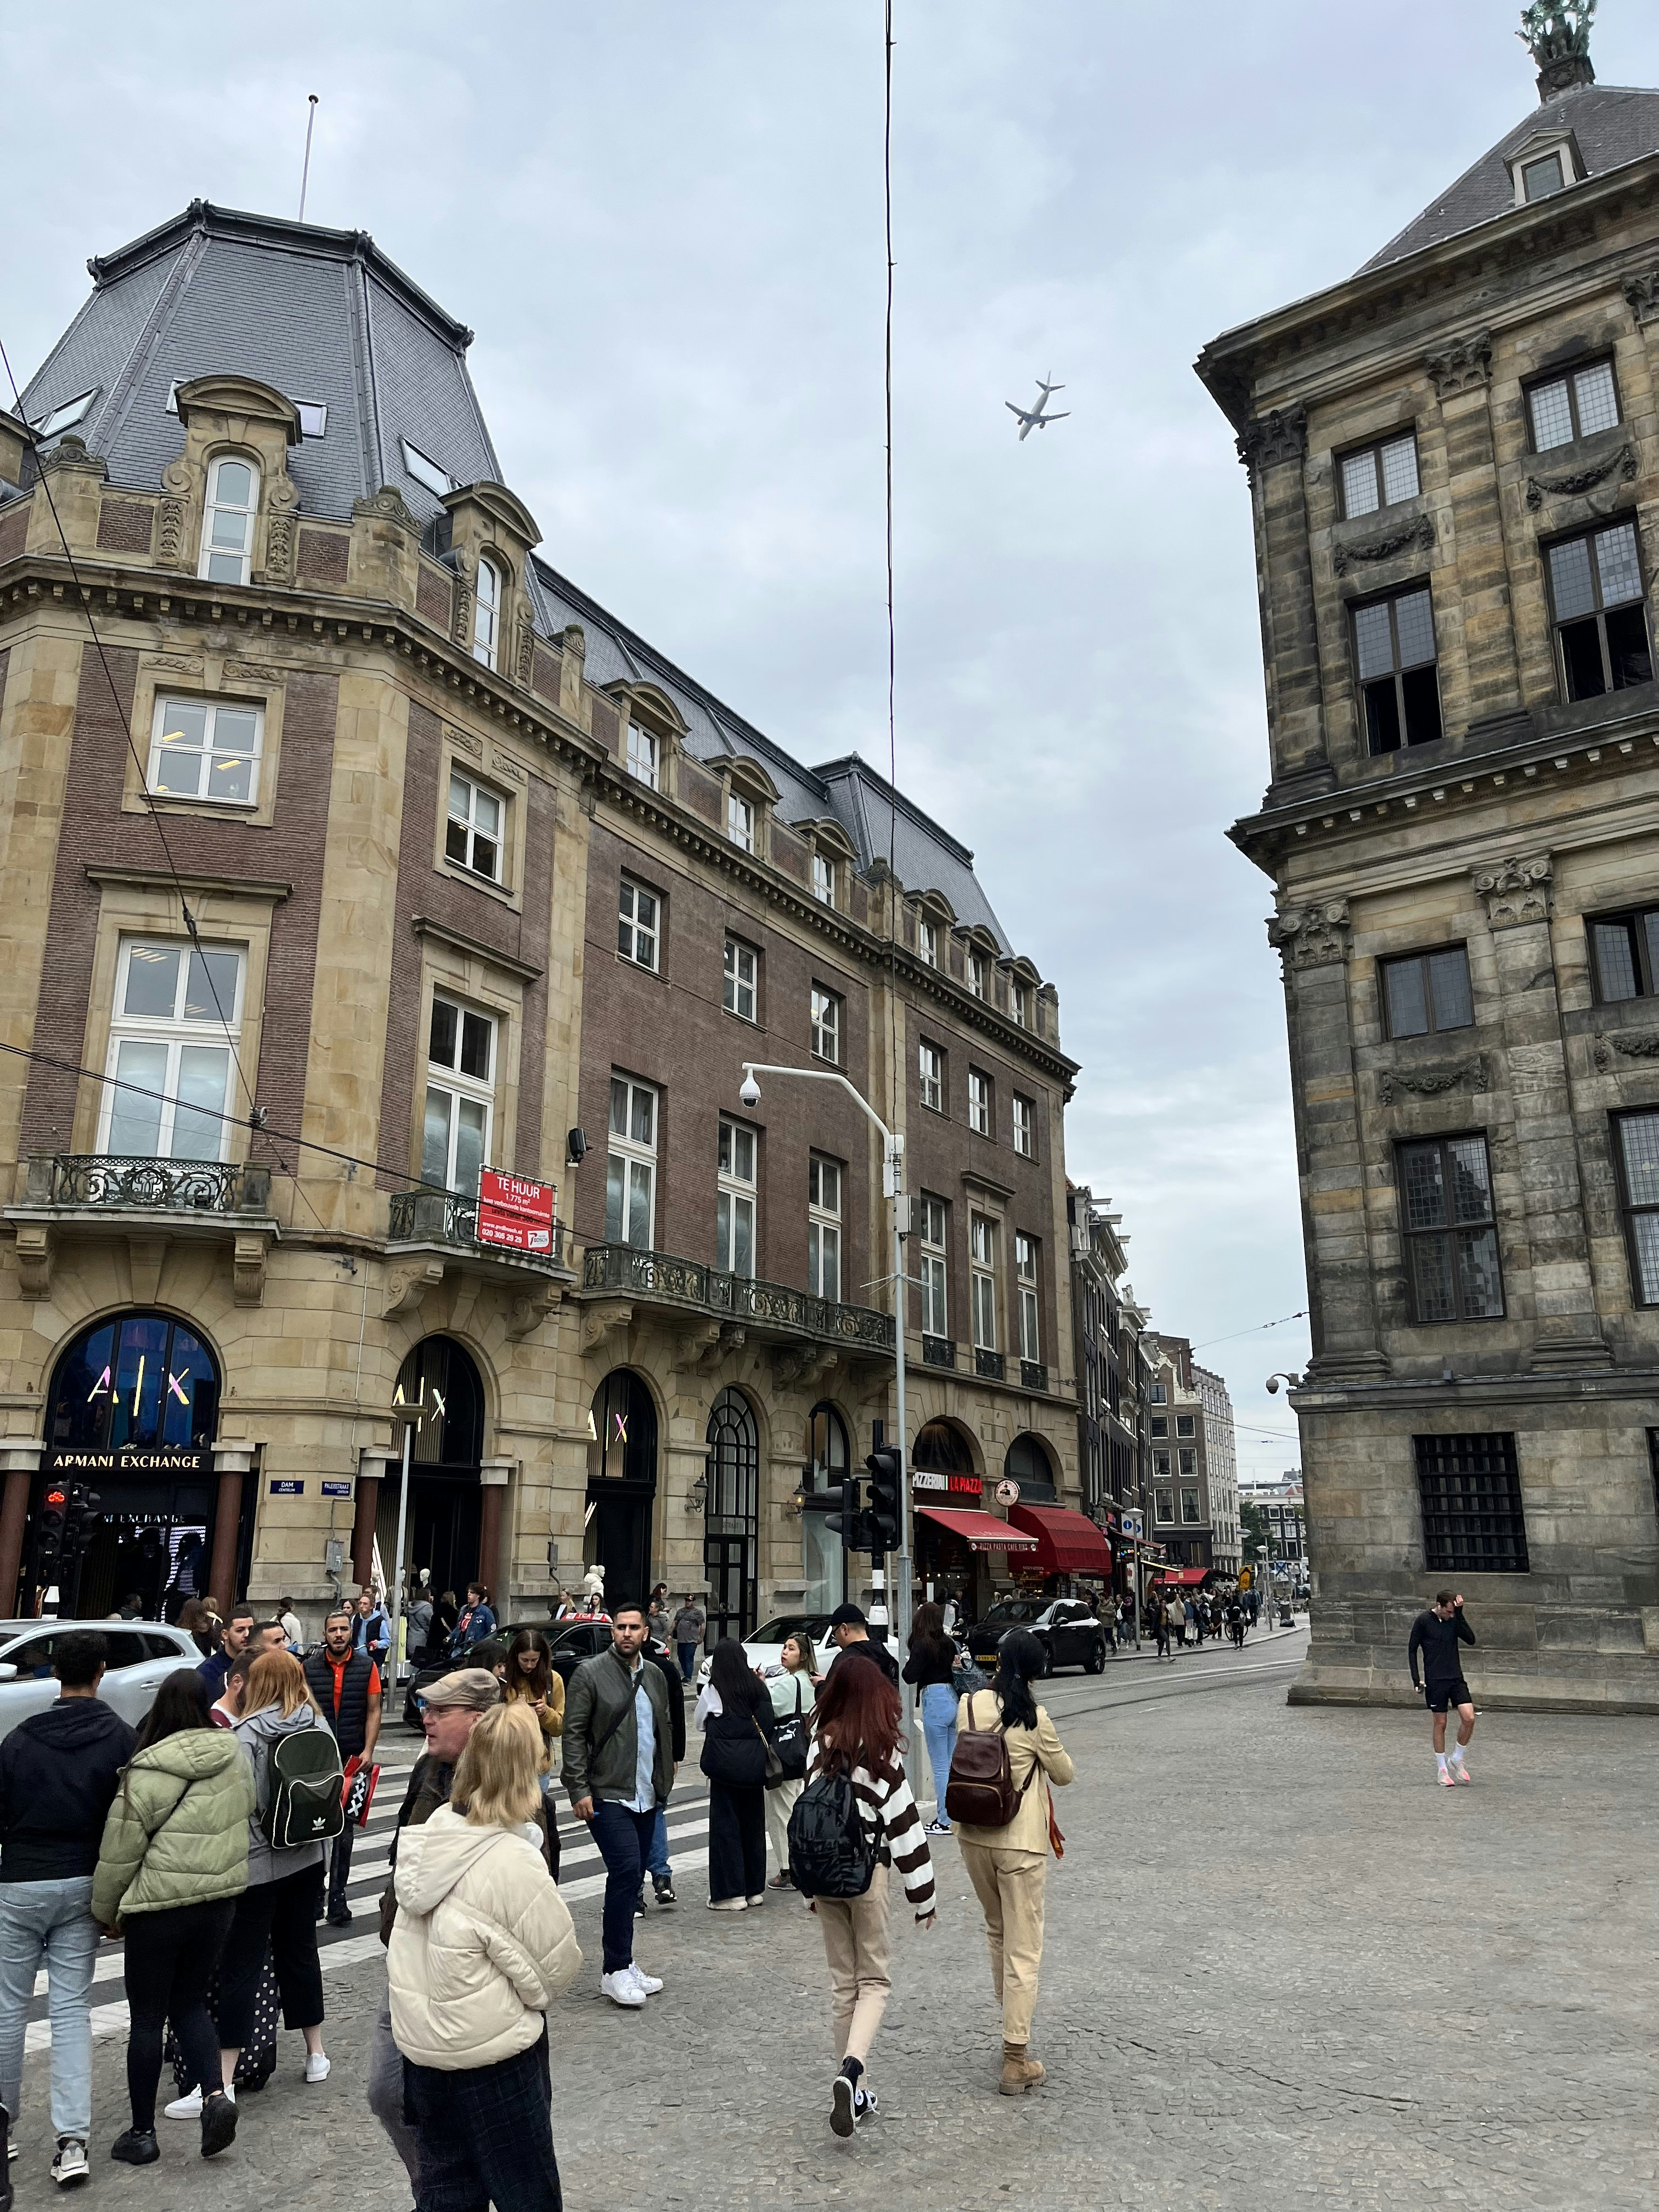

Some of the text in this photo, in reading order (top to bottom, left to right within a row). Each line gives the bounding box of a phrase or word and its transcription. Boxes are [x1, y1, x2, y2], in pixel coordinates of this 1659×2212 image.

[497, 1176, 540, 1199] TE HUUR
[506, 1193, 522, 1204] 1.775
[482, 1228, 494, 1237] 020
[53, 1455, 201, 1468] ARMANI EXCHANGE
[912, 1472, 983, 1495] PIZZERIA LA PIAZZA
